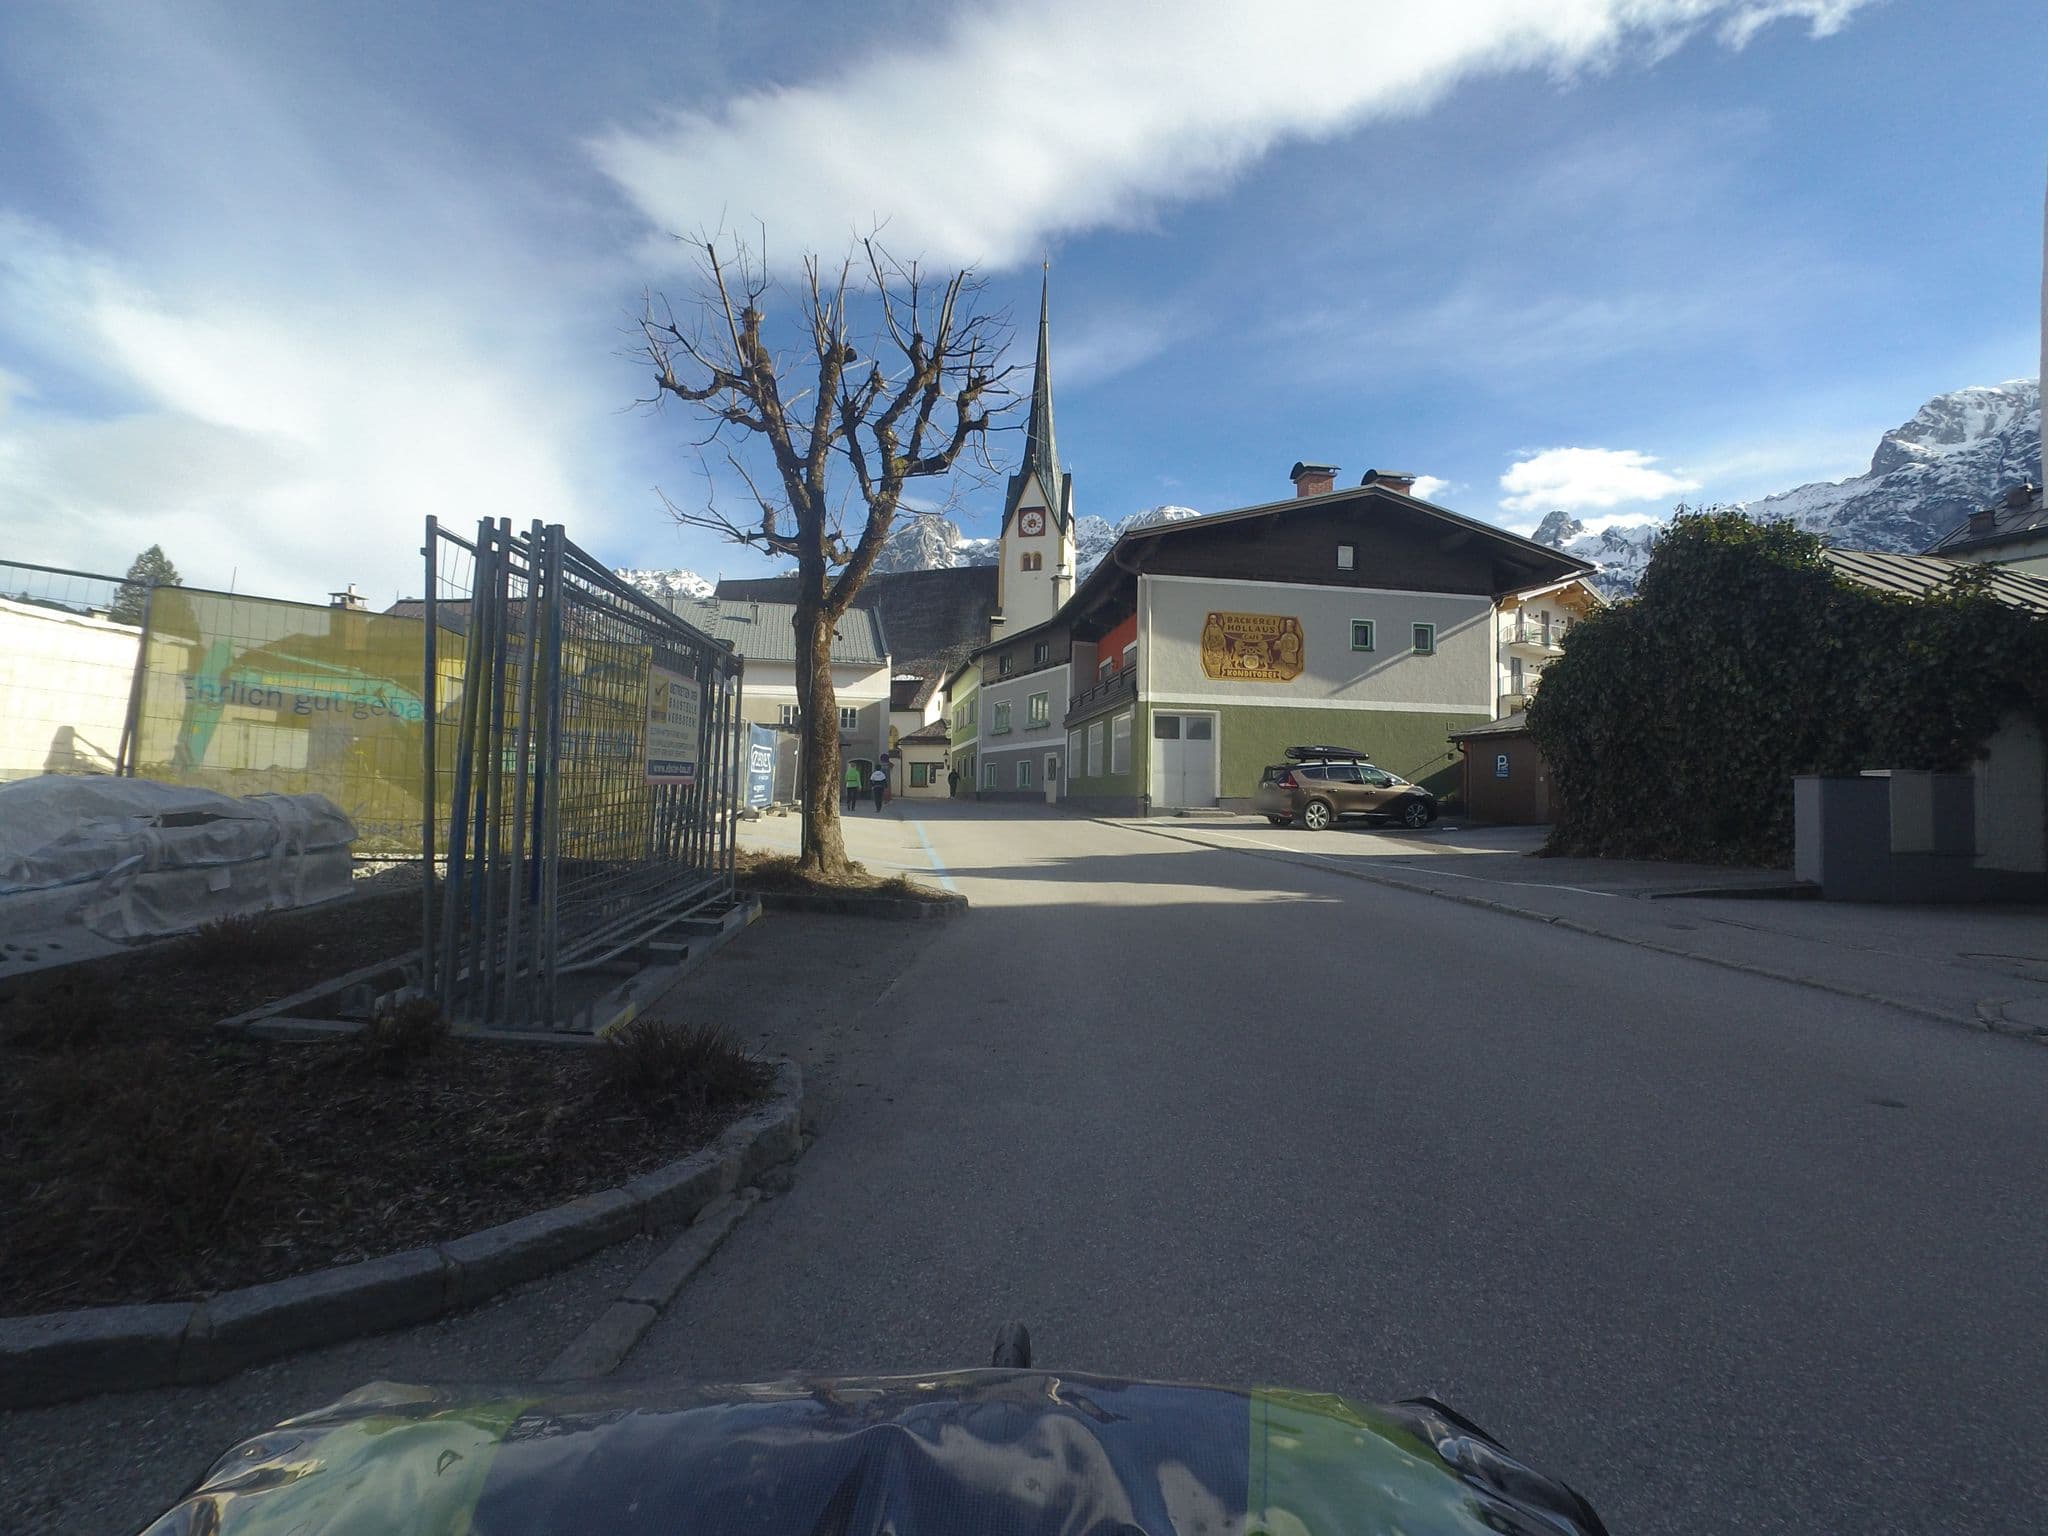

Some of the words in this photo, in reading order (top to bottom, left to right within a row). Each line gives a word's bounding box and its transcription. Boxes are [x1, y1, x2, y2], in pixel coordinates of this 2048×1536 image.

[1227, 625, 1275, 633] HOLLAUS
[1226, 669, 1277, 678] KONDITOREI
[294, 692, 344, 716] gut
[1498, 755, 1507, 771] P
